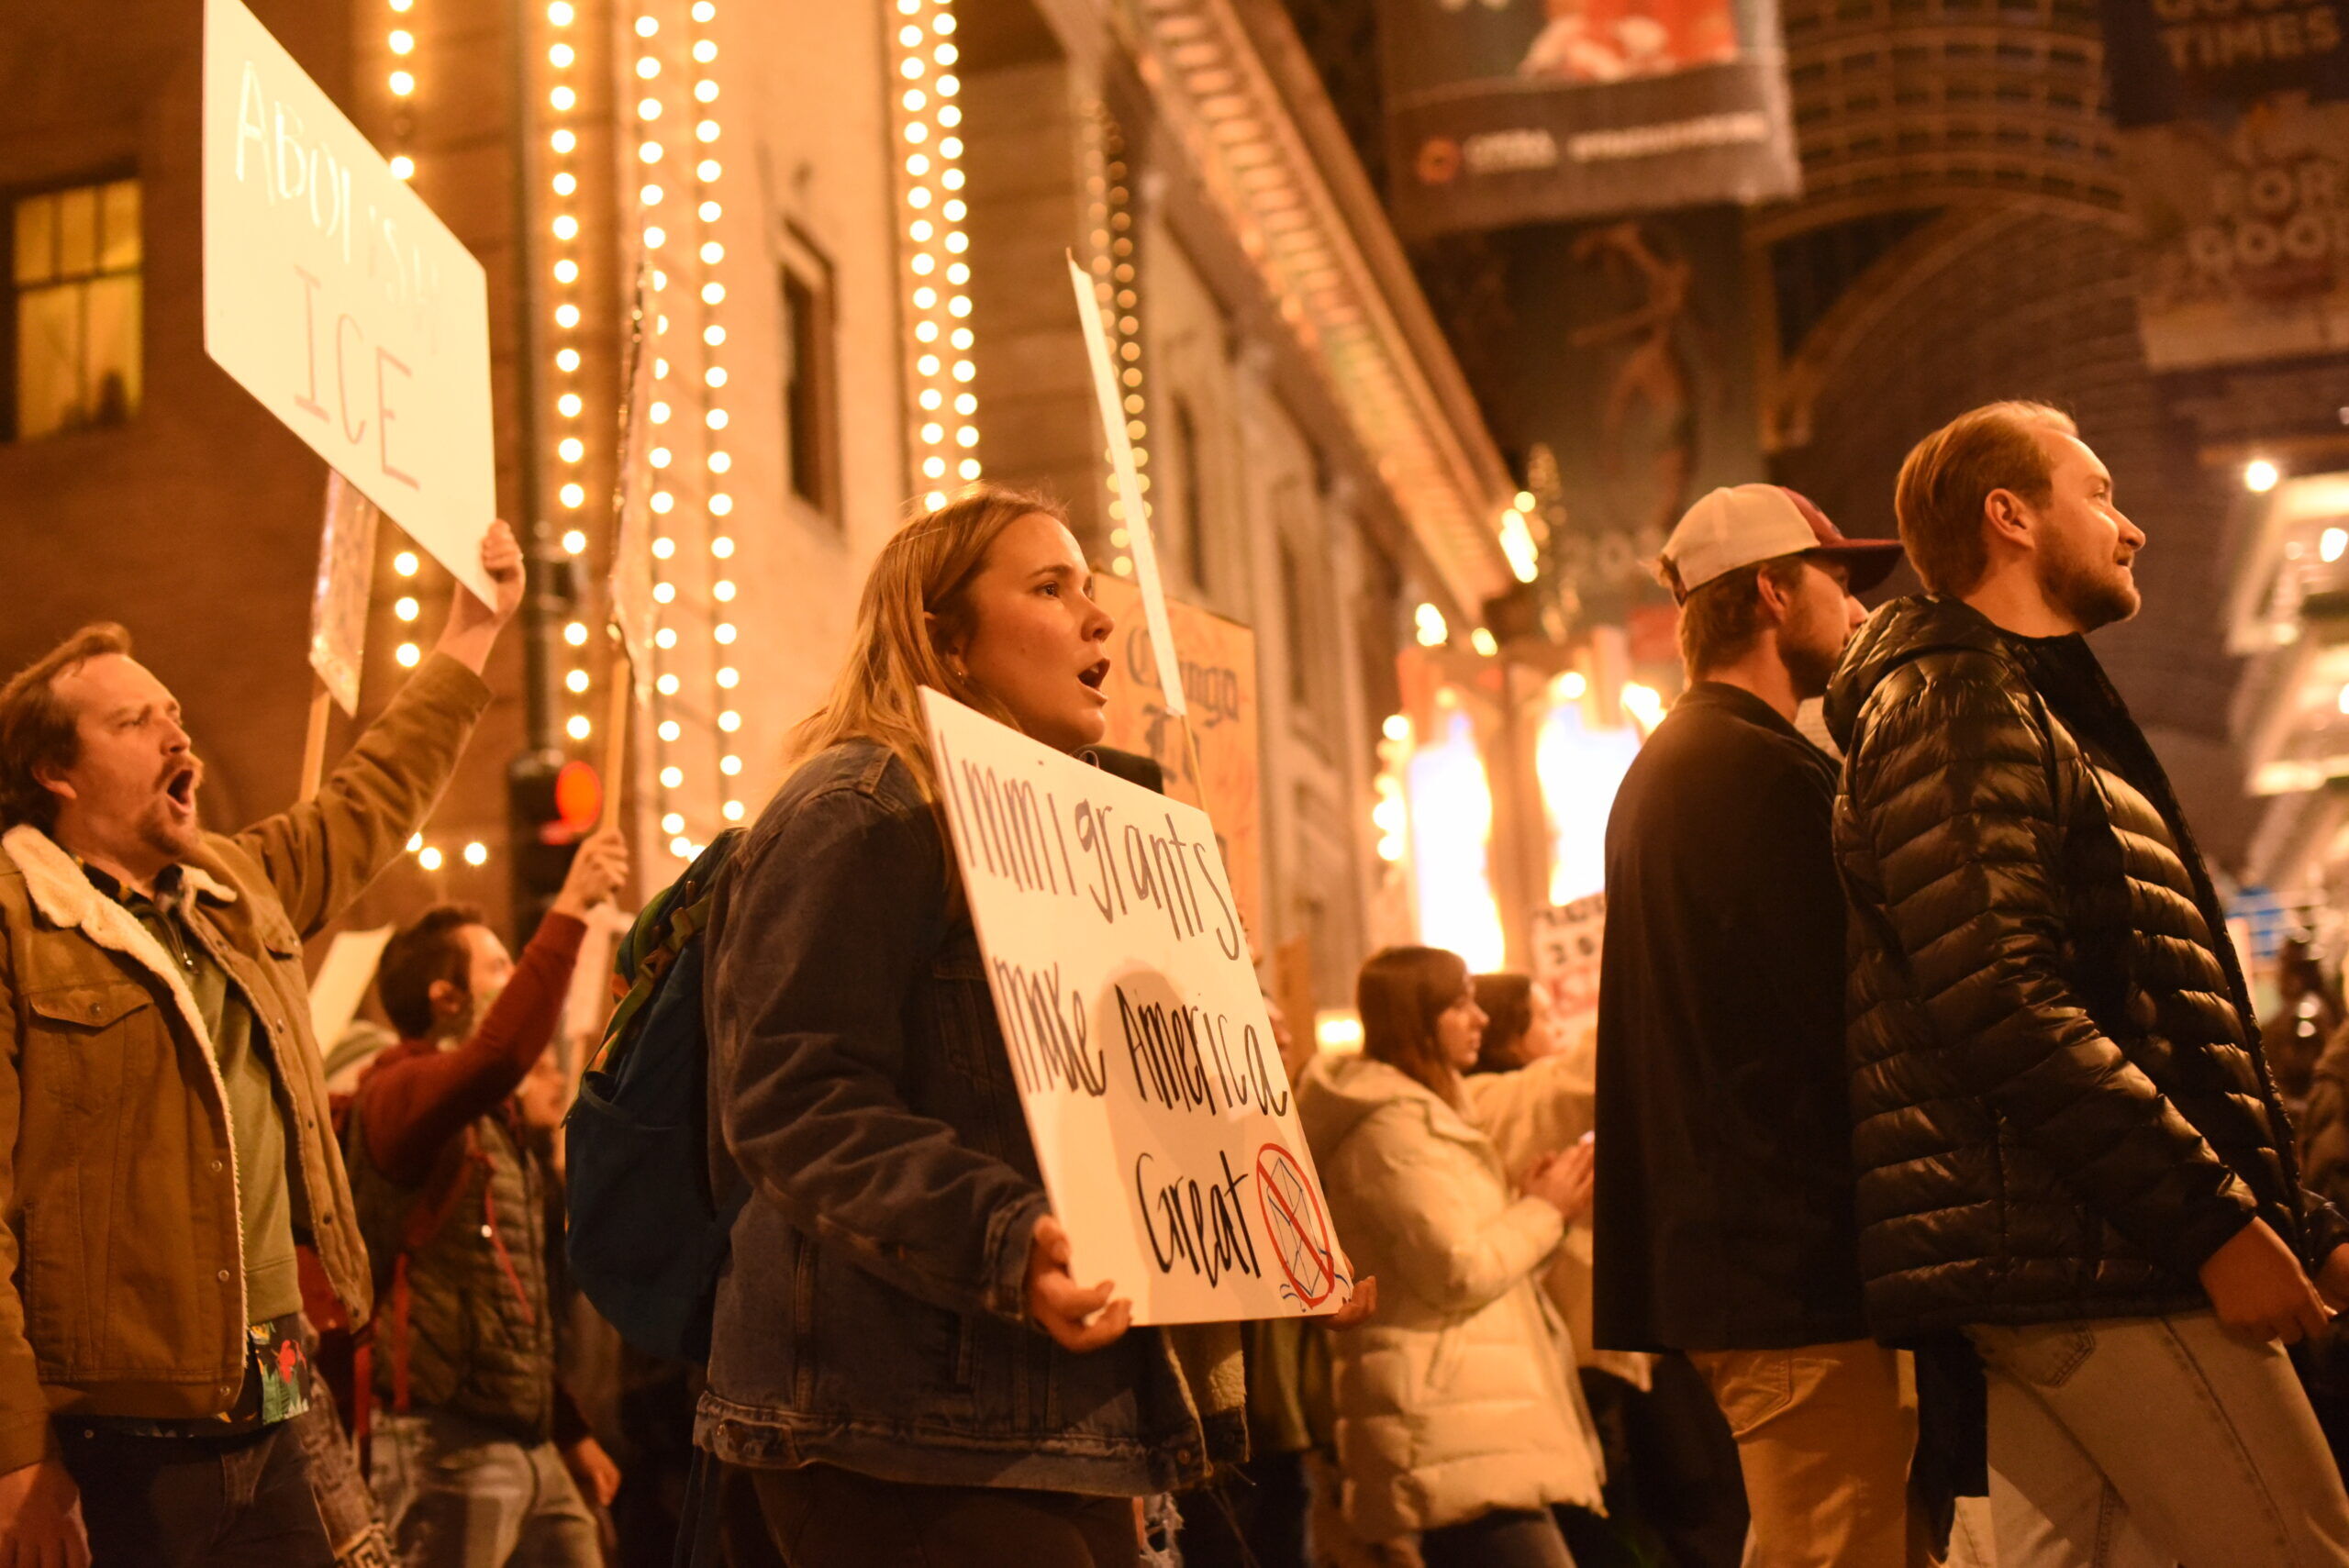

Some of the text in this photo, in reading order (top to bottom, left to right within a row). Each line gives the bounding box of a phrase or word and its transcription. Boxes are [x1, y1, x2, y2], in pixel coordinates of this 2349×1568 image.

[293, 263, 420, 491] ICE
[939, 728, 1240, 962] Immigrants
[1114, 984, 1288, 1118] America
[1135, 1150, 1261, 1288] Great
